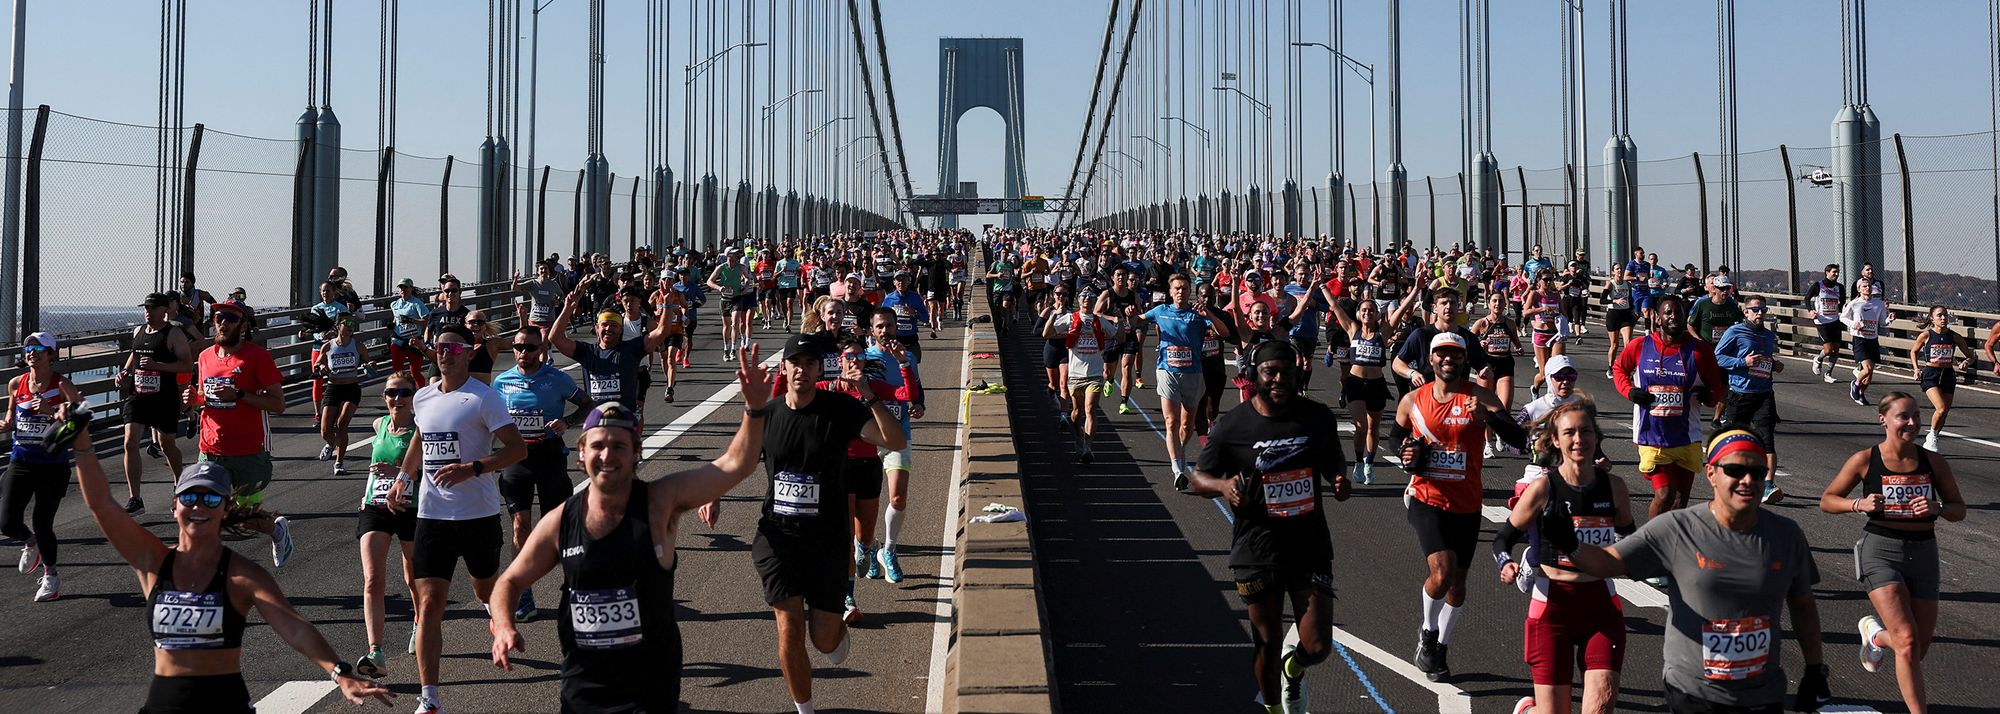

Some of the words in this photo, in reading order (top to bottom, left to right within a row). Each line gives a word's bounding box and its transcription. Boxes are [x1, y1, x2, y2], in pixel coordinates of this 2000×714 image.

[1358, 345, 1380, 355] 29135
[592, 381, 618, 390] 27243
[1656, 393, 1681, 403] 7860
[424, 442, 456, 455] 27154
[1252, 437, 1309, 449] NIKE
[1430, 451, 1464, 465] 9954
[778, 482, 815, 499] 27321
[1267, 479, 1311, 499] 27909
[1886, 485, 1930, 500] 29997
[1576, 529, 1612, 545] 0134
[563, 545, 584, 558] HOKA
[159, 607, 217, 628] 27277
[575, 602, 635, 624] 33533
[1709, 632, 1767, 654] 27502
